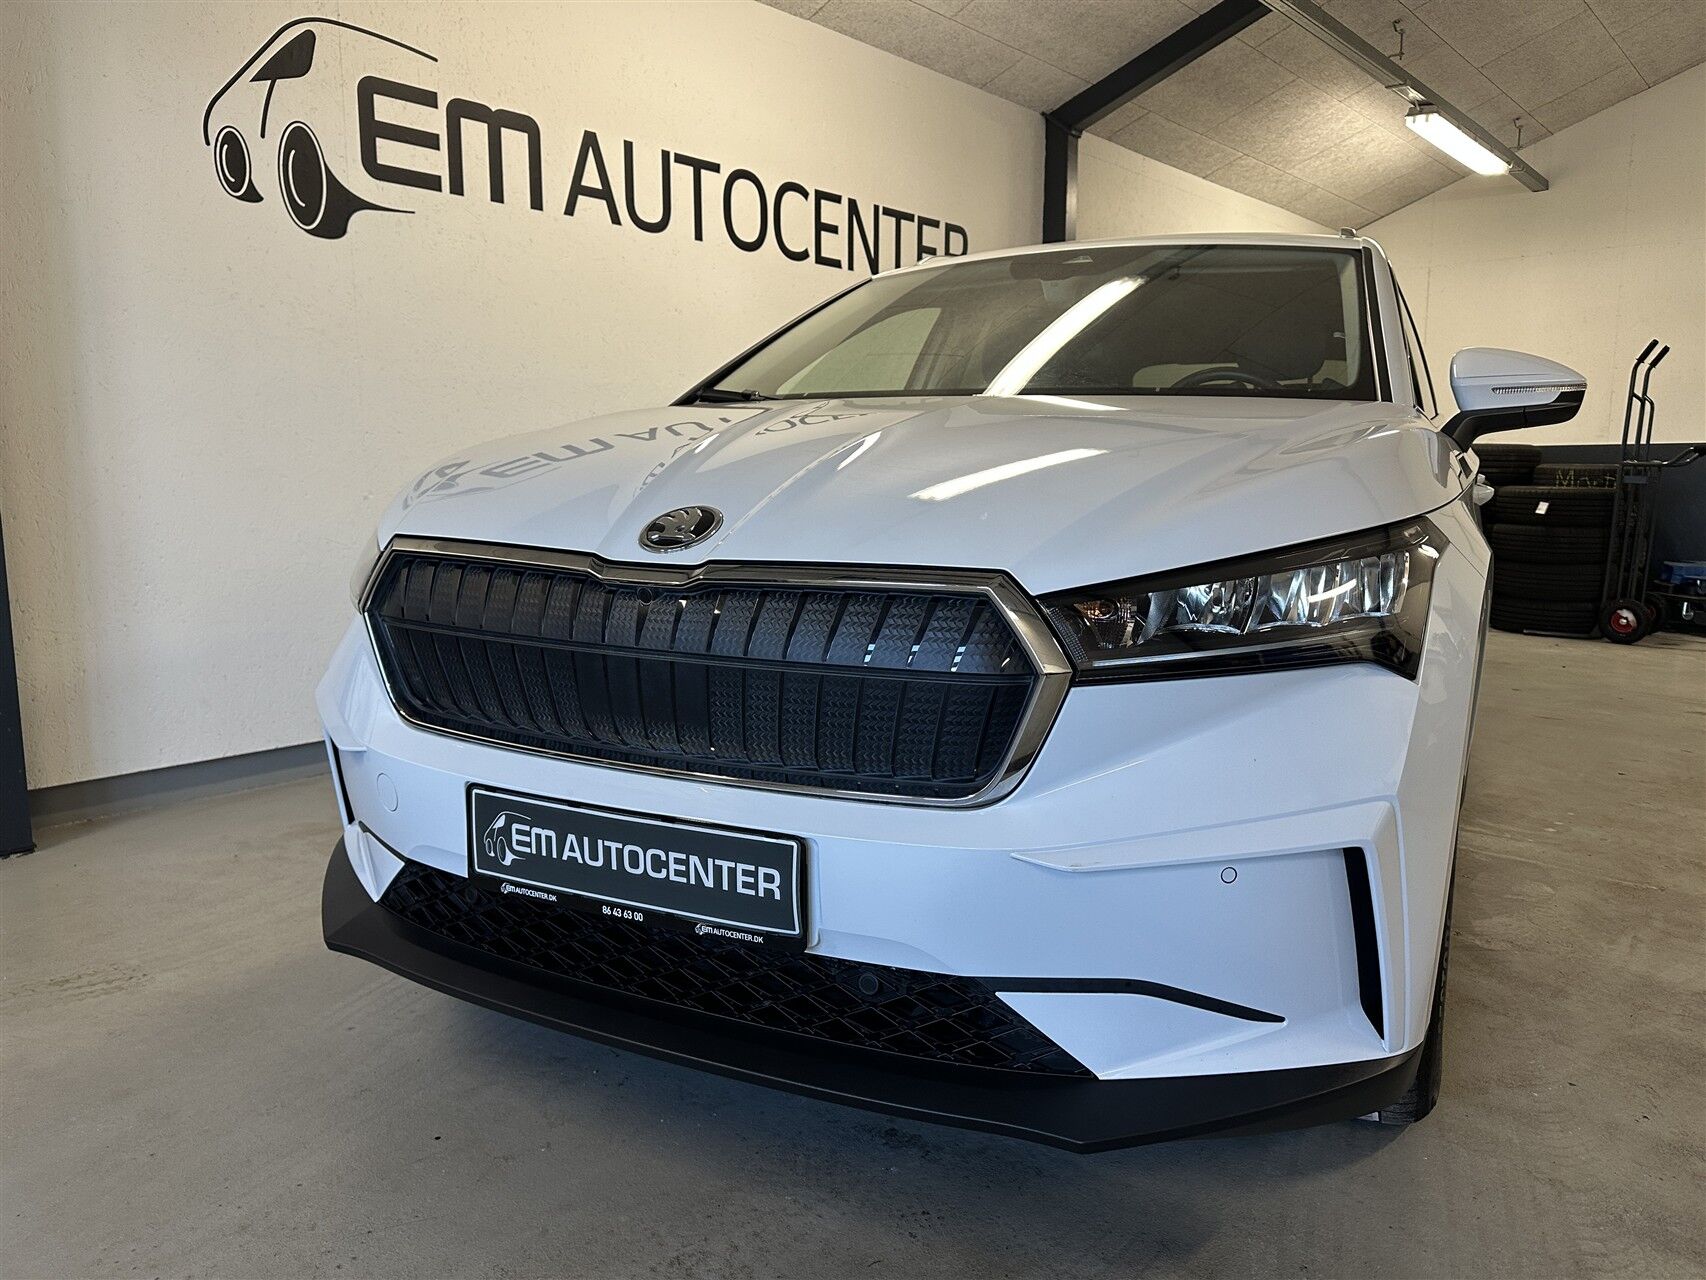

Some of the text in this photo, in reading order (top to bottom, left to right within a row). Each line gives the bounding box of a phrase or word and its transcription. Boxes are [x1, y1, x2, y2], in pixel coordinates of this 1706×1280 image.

[357, 75, 544, 212] EM
[562, 833, 781, 901] AUTOCENTER
[515, 886, 558, 902] AUTOCENTER.DK
[602, 905, 644, 922] 86 43 63 00
[713, 928, 764, 945] AUTOCENTER.DK
